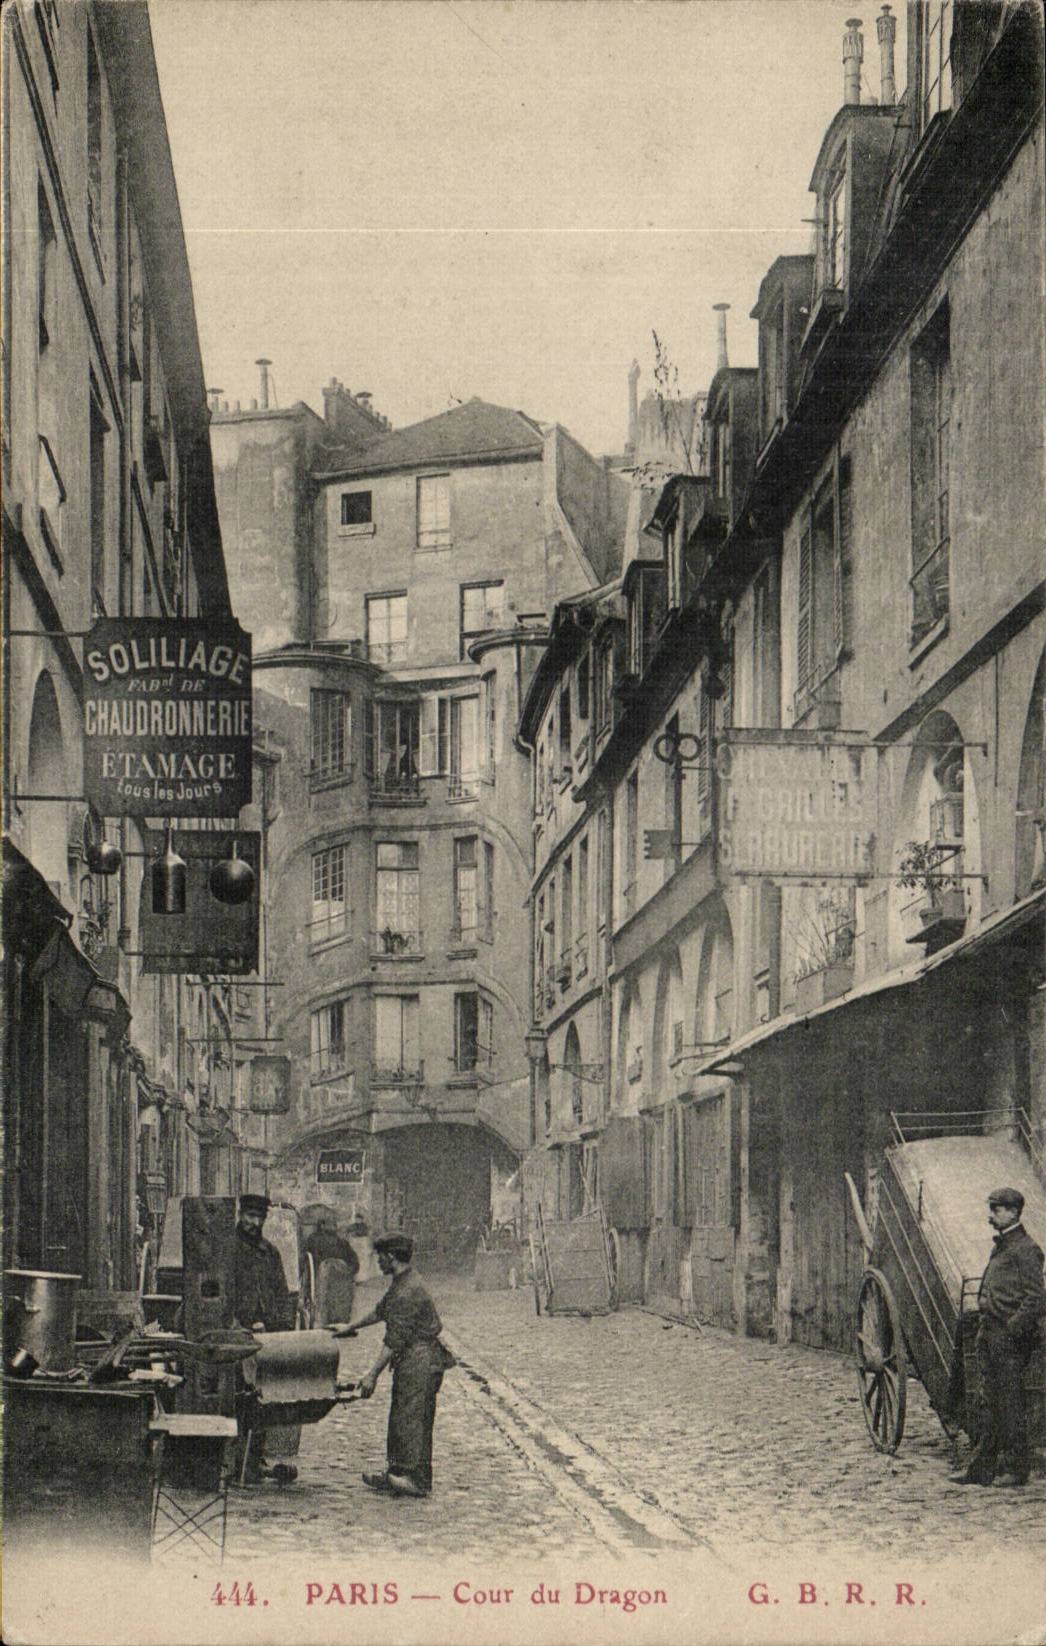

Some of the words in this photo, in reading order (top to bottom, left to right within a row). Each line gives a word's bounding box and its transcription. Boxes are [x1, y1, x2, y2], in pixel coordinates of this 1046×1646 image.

[87, 636, 249, 685] SOLILIAGE
[180, 679, 206, 692] DE
[85, 700, 250, 736] CHAUDRONNERIE
[117, 779, 150, 798] tous
[154, 780, 174, 800] les
[320, 1162, 360, 1173] BLANC
